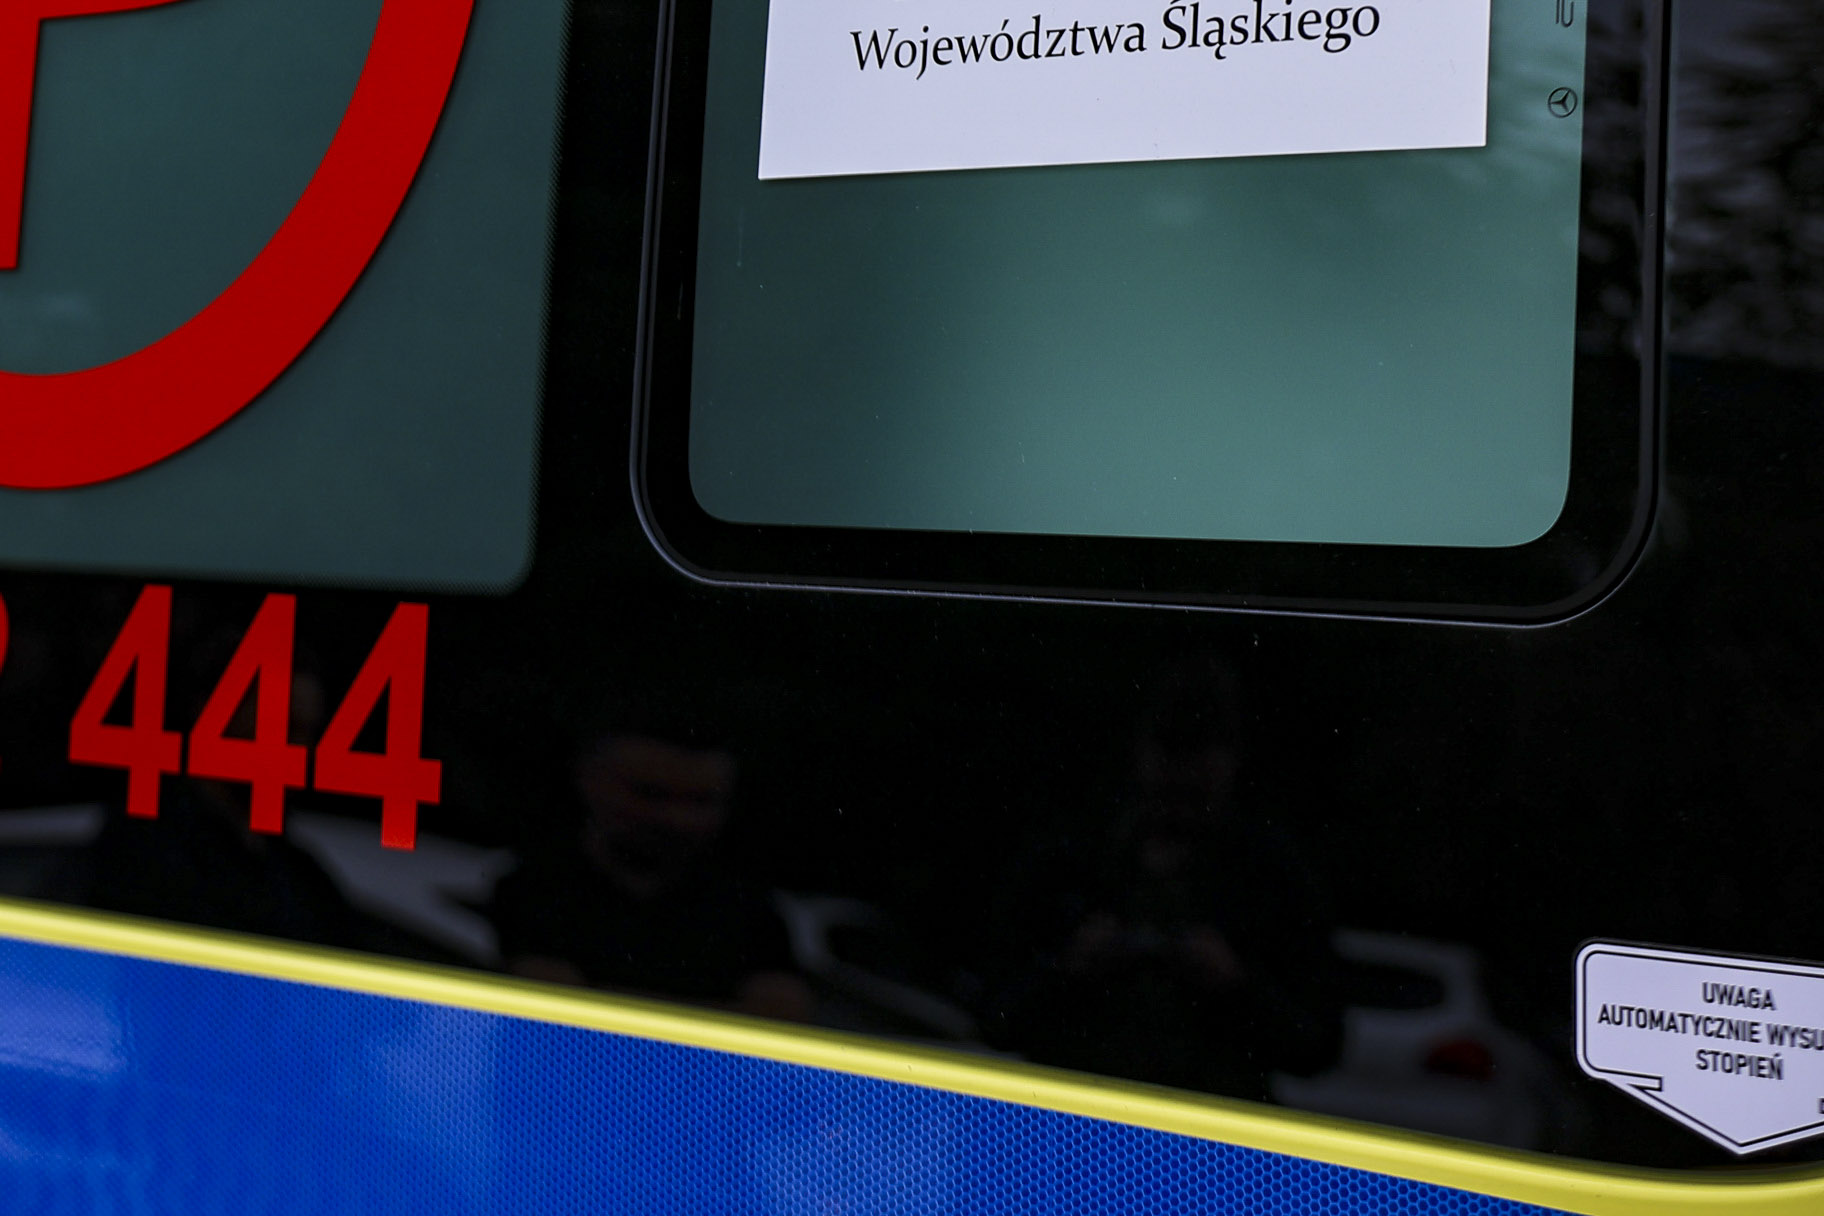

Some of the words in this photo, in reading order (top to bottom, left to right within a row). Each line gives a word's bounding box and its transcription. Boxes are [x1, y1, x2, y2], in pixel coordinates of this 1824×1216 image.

[850, 15, 1147, 81] Województwa
[68, 583, 442, 851] 444
[1702, 982, 1775, 1010] UWAGA
[1598, 1003, 1762, 1044] AUTOMATYCZNIE
[1695, 1048, 1784, 1080] STOPIEŃ
